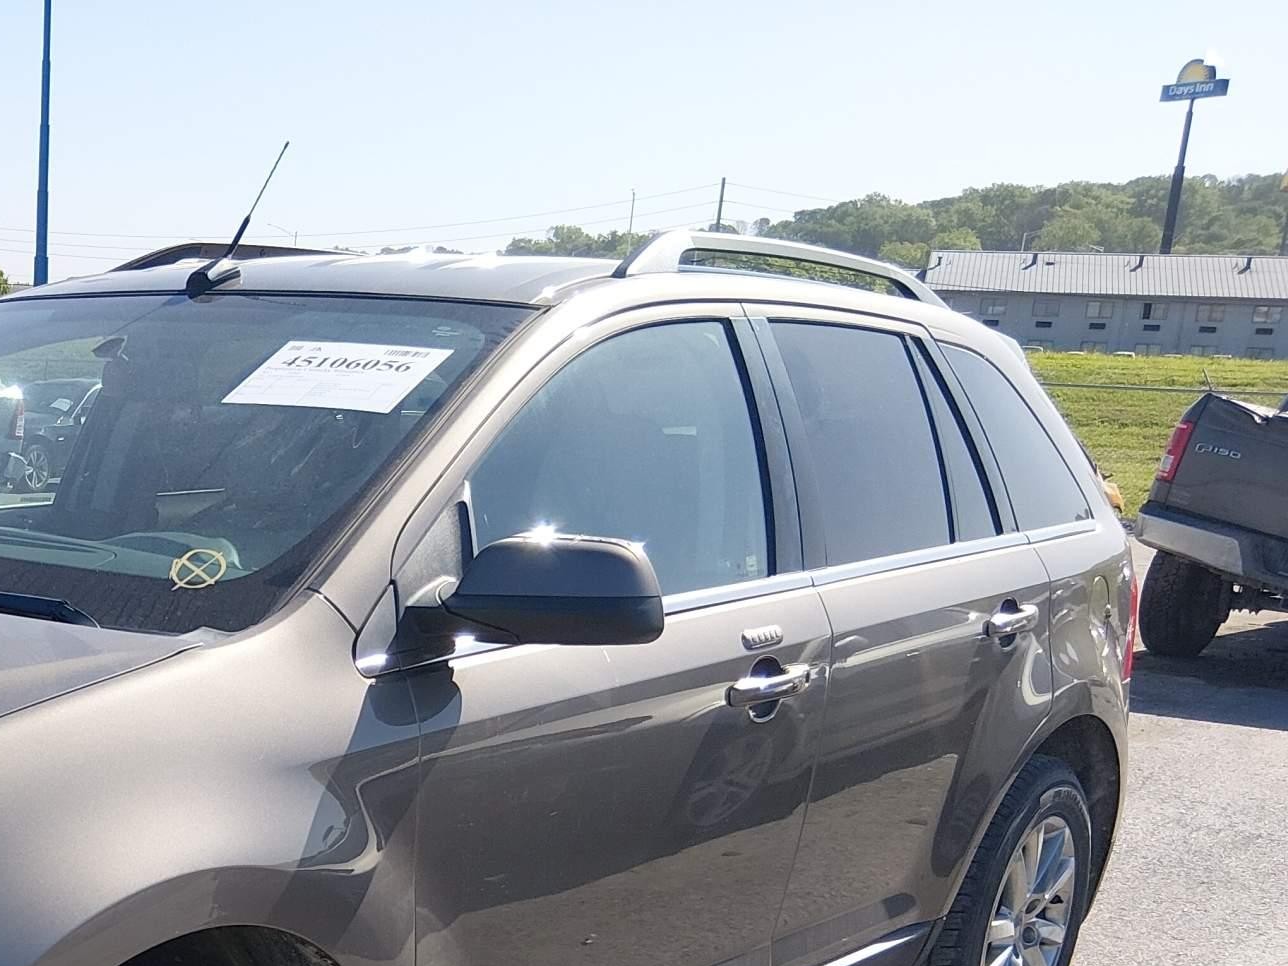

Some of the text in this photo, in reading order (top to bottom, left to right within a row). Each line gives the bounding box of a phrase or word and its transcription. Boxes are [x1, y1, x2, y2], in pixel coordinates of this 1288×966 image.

[1168, 82, 1214, 96] Days Inn
[281, 355, 416, 373] 45106056
